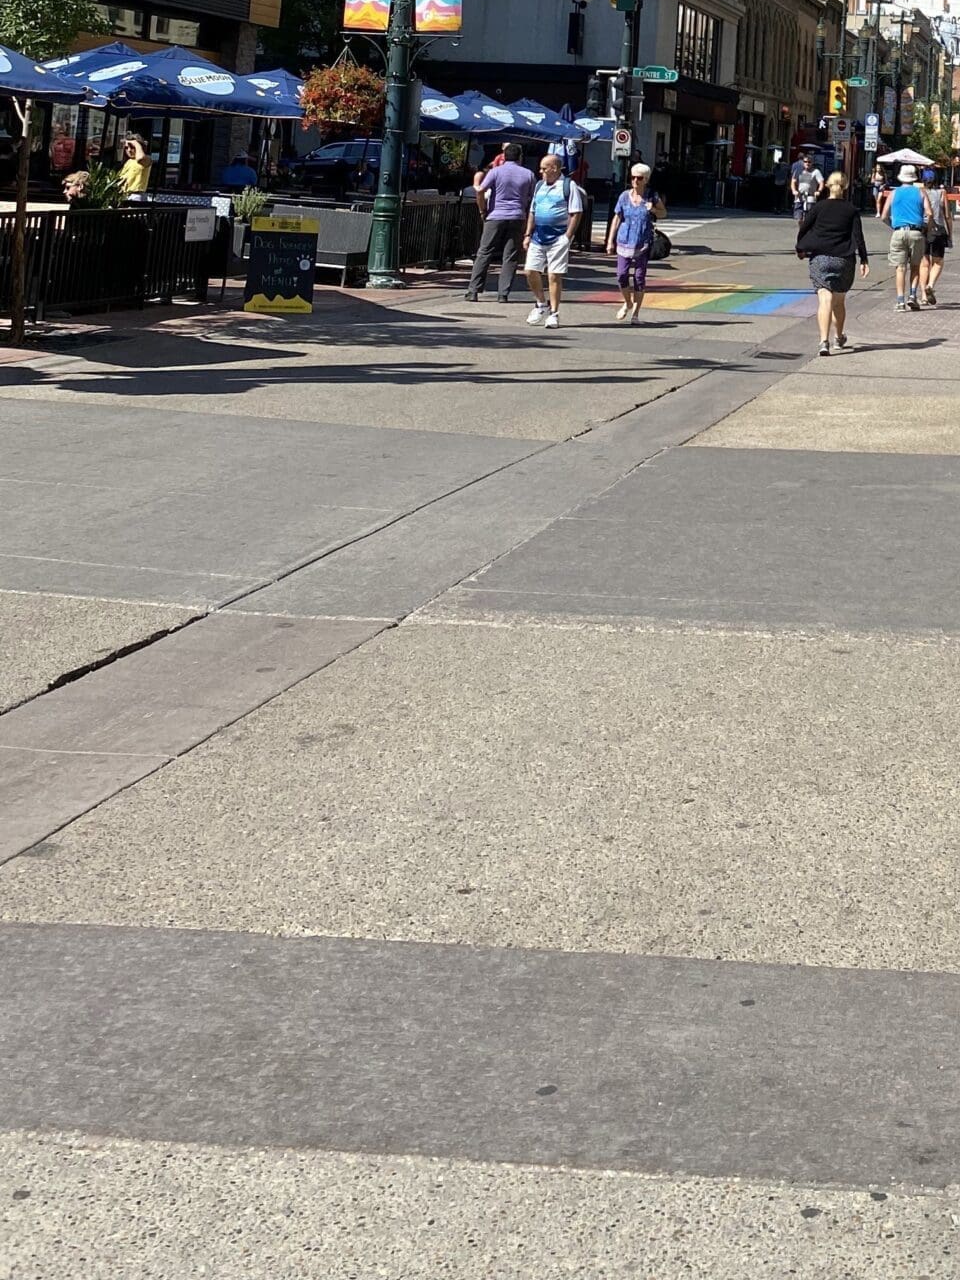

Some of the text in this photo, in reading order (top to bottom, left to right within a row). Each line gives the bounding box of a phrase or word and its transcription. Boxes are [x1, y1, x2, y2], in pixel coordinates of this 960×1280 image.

[180, 74, 232, 85] BLUE MOON
[638, 70, 673, 80] CENTRE ST
[865, 141, 877, 149] 30
